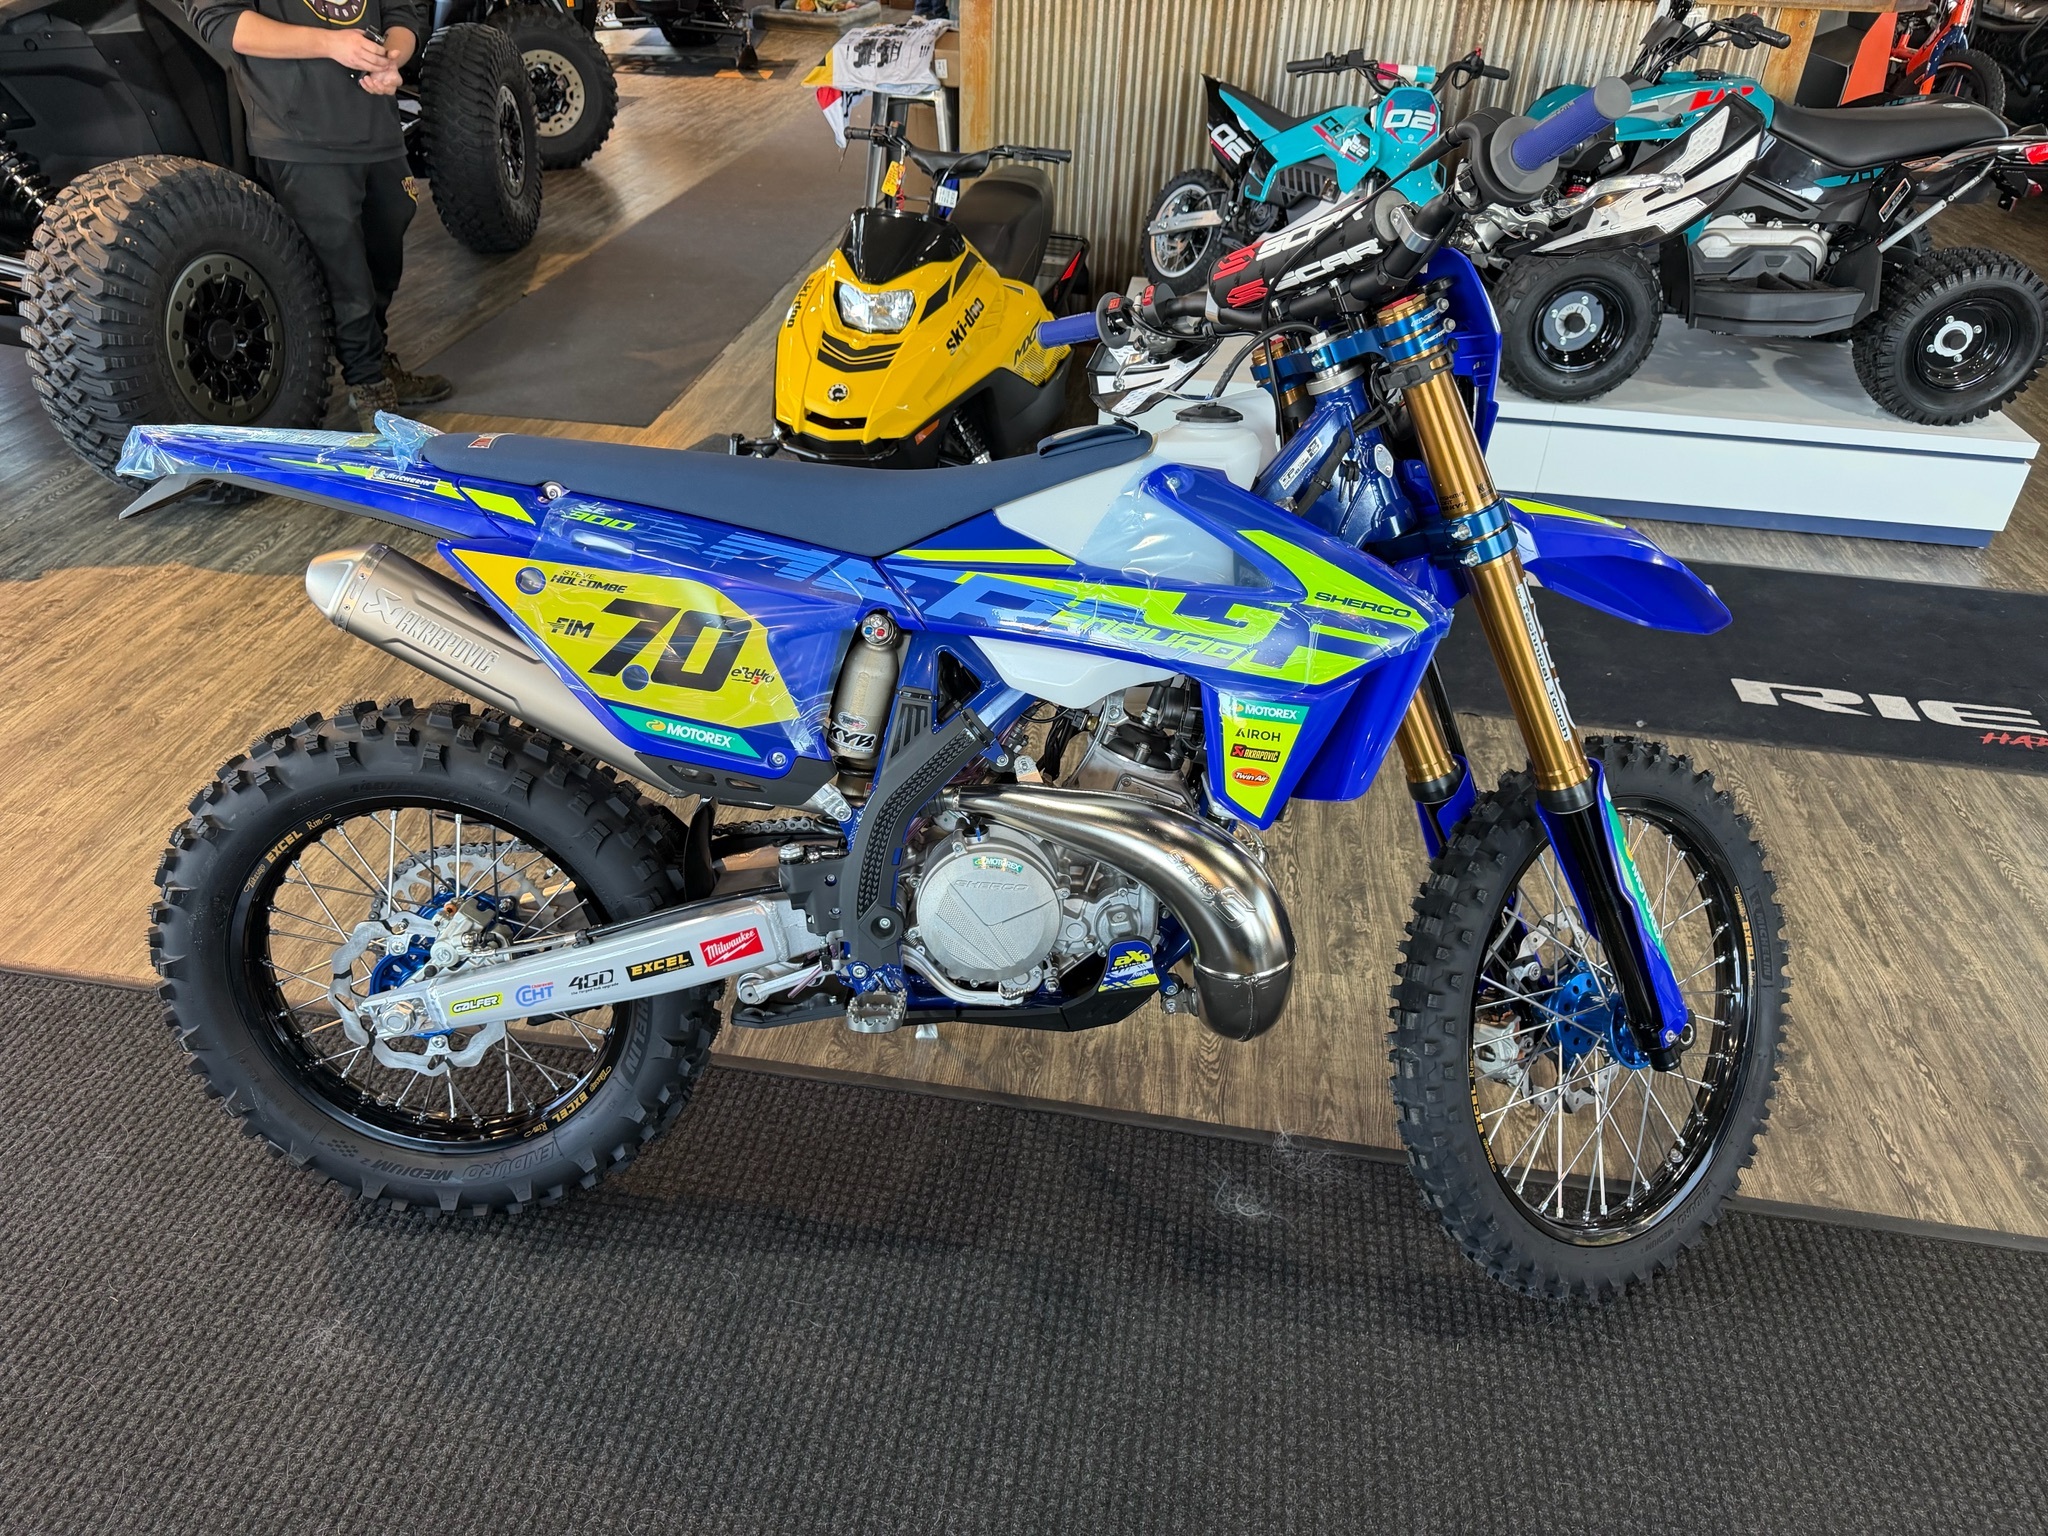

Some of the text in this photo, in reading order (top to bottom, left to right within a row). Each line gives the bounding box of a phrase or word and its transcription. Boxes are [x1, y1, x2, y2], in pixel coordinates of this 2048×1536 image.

[1383, 109, 1436, 131] 02
[1210, 123, 1252, 164] 02
[1269, 238, 1383, 291] SCAR
[946, 298, 984, 355] ski-doo
[550, 574, 628, 593] HOLCOMBE
[563, 570, 596, 579] STEVE
[1314, 591, 1411, 618] SHERCO
[547, 617, 595, 638] FIM
[588, 598, 753, 692] 70
[1522, 602, 1550, 682] Technical
[1548, 690, 1570, 739] Touch
[1245, 704, 1297, 719] MOTOREX
[667, 723, 733, 748] MOTOREX
[830, 722, 877, 748] KYB
[1235, 728, 1281, 742] AIROH
[1235, 771, 1270, 782] Twin Air
[265, 831, 303, 863] EXCEL
[306, 814, 331, 830] Rim
[987, 857, 1020, 871] MOTOREX
[704, 930, 755, 960] Milwaukee
[1742, 922, 1754, 960] EXCEL
[1756, 913, 1771, 977] MICHELIN
[631, 954, 689, 976] EXCEL
[552, 1091, 588, 1122] EXCEL
[1471, 1085, 1484, 1134] EXCEL
[371, 1159, 453, 1183] MEDIUM
[464, 1142, 554, 1180] ENDURO
